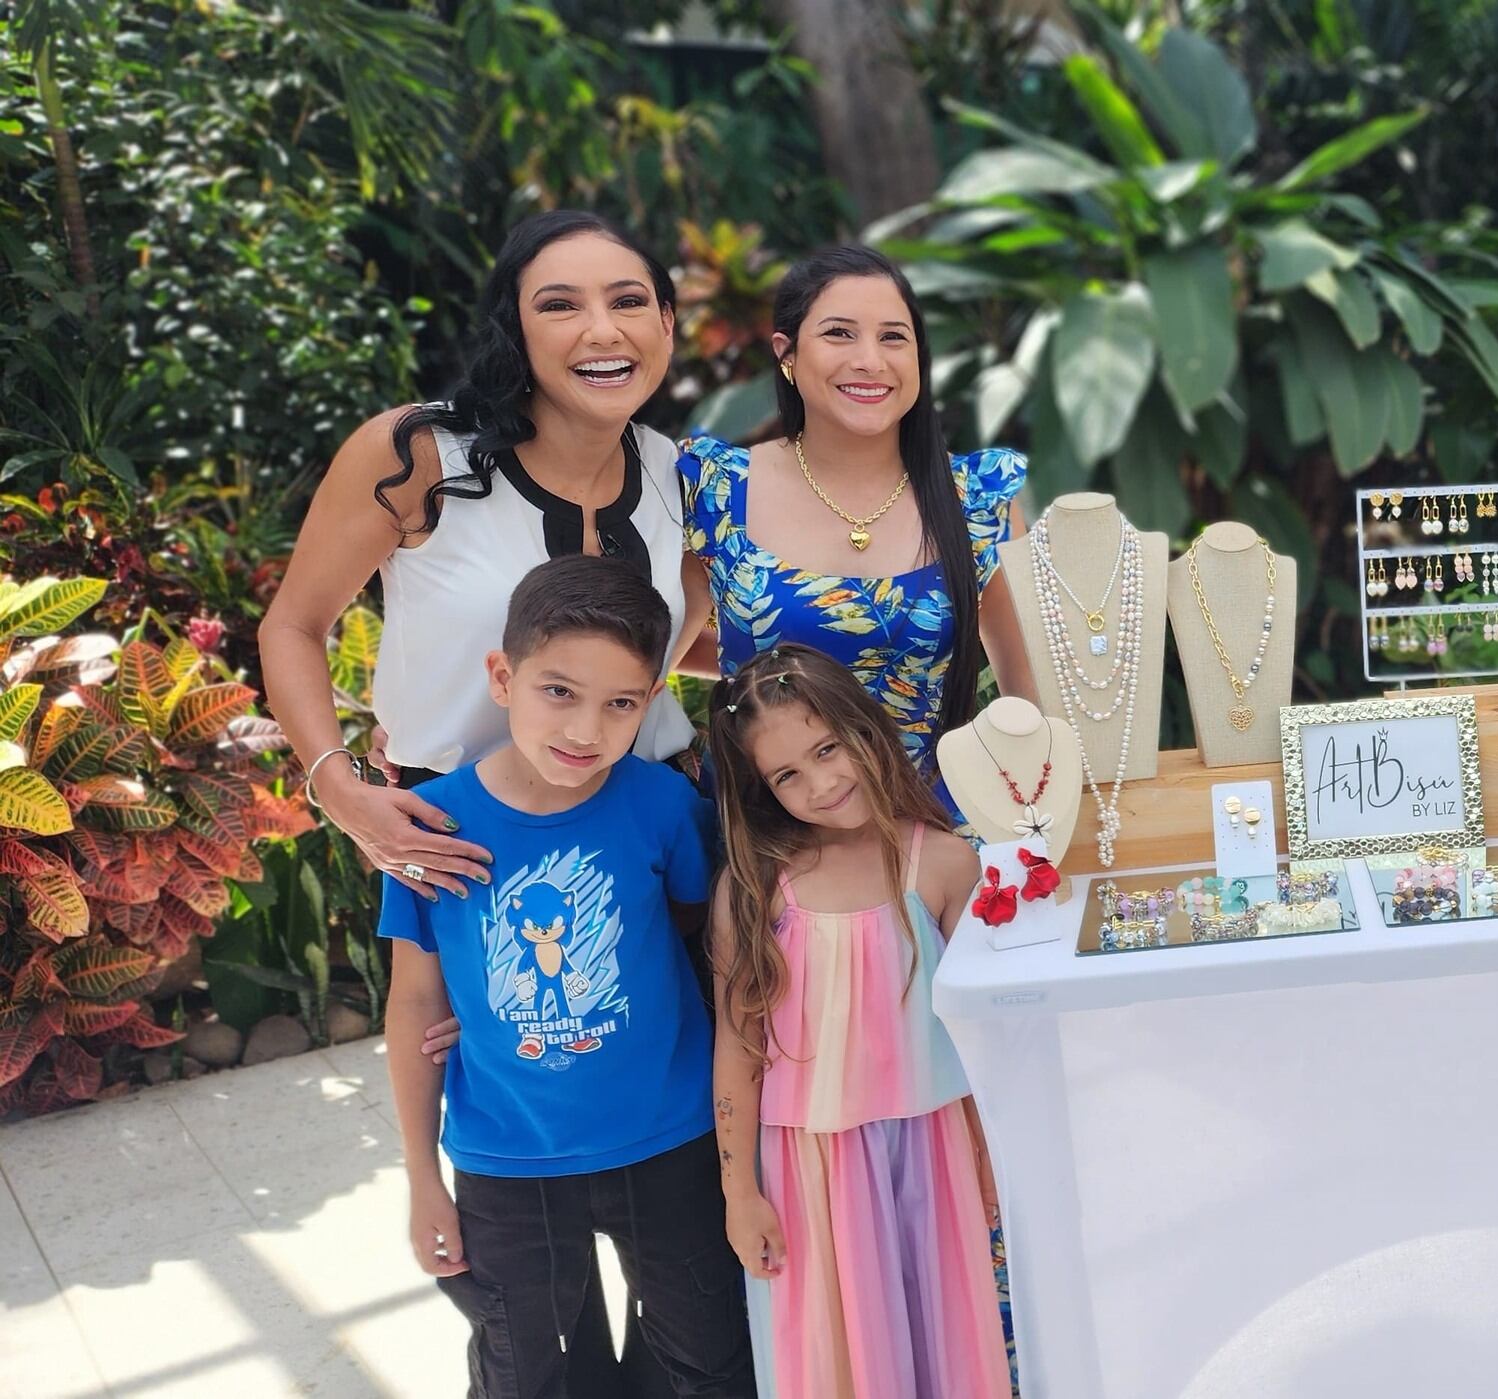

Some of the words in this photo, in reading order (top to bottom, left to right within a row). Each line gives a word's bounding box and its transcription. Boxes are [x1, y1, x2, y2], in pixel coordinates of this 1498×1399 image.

[1412, 803, 1430, 817] BY
[1435, 801, 1456, 815] LIZ
[499, 1008, 506, 1021] I
[510, 1010, 538, 1021] am
[518, 1017, 583, 1033] ready
[546, 1033, 574, 1044] to
[578, 1020, 617, 1040] roll
